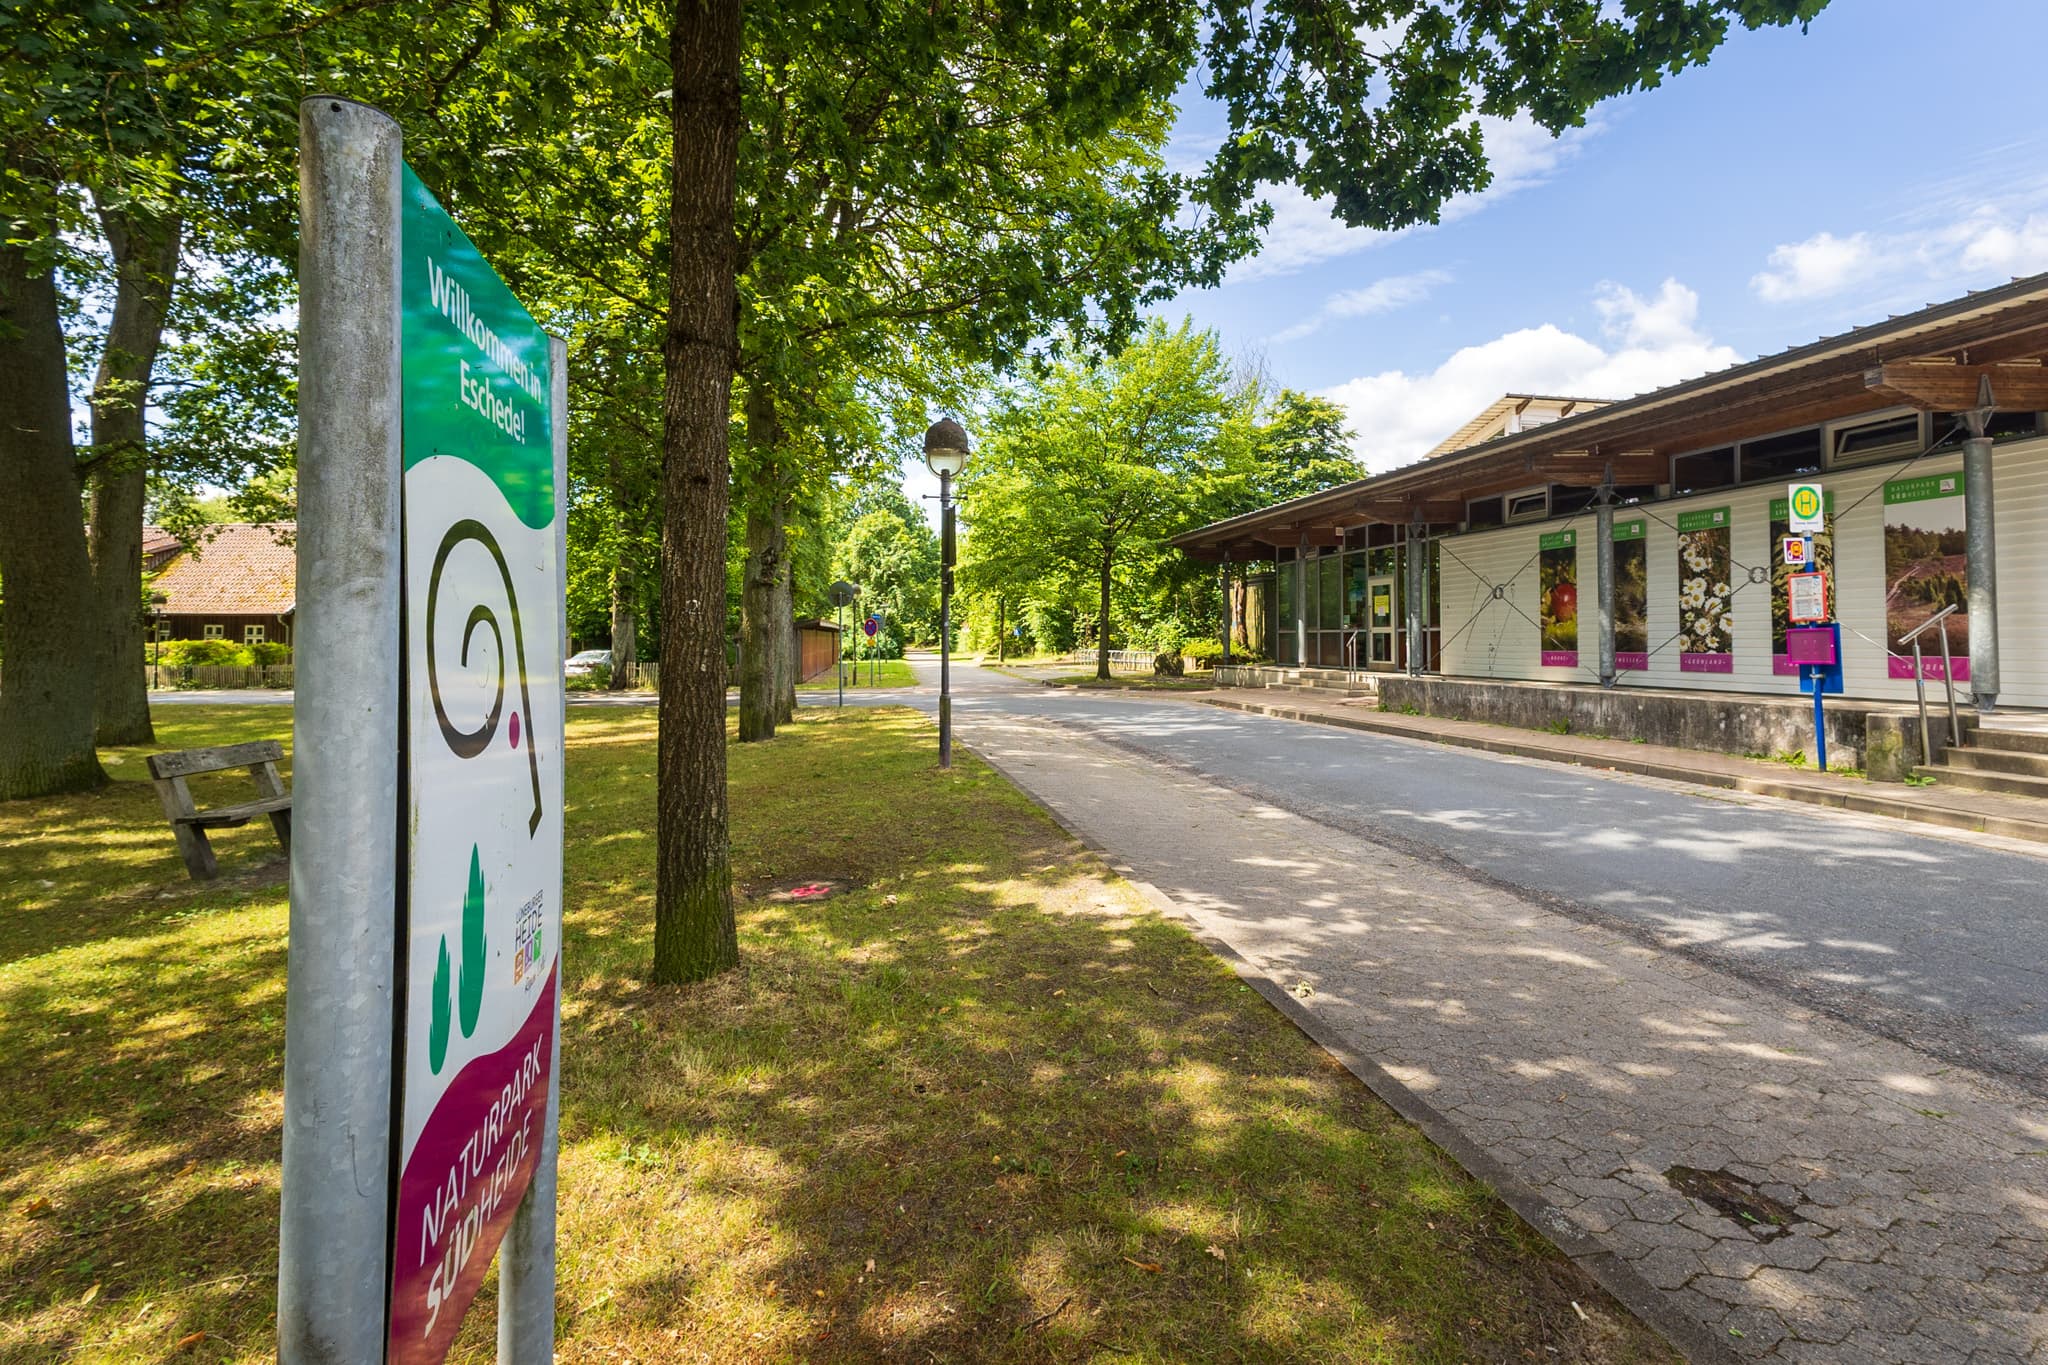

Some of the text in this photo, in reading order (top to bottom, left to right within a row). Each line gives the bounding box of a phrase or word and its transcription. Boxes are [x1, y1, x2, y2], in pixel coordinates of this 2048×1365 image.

[427, 256, 542, 405] Willkommen in
[460, 358, 525, 445] Eschede!
[1800, 493, 1812, 513] H
[515, 903, 543, 954] HEIDE
[420, 1033, 543, 1267] NATURPARK
[424, 1108, 532, 1338] SÜDHEIDE
